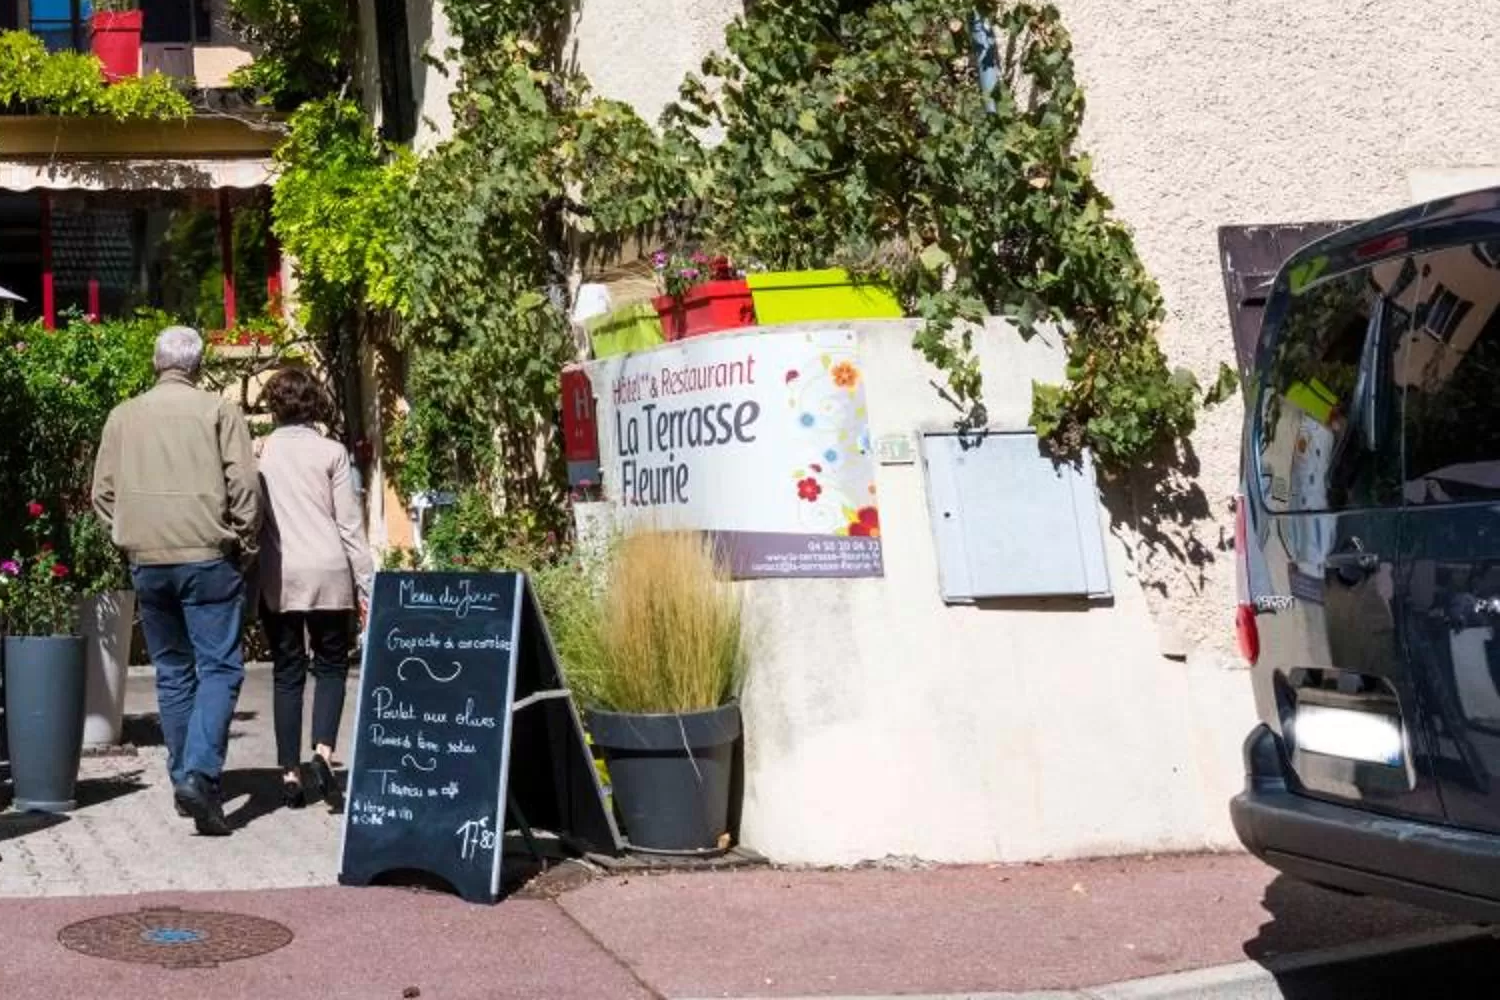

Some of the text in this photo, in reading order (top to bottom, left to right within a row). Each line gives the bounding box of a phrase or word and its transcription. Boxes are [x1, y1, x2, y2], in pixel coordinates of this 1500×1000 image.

[660, 353, 756, 397] Restaurant
[616, 399, 761, 457] La Terrasse
[621, 452, 690, 508] Fleurie
[399, 579, 435, 607] Menu
[439, 585, 460, 605] du
[371, 686, 497, 729] Poulet aux olives
